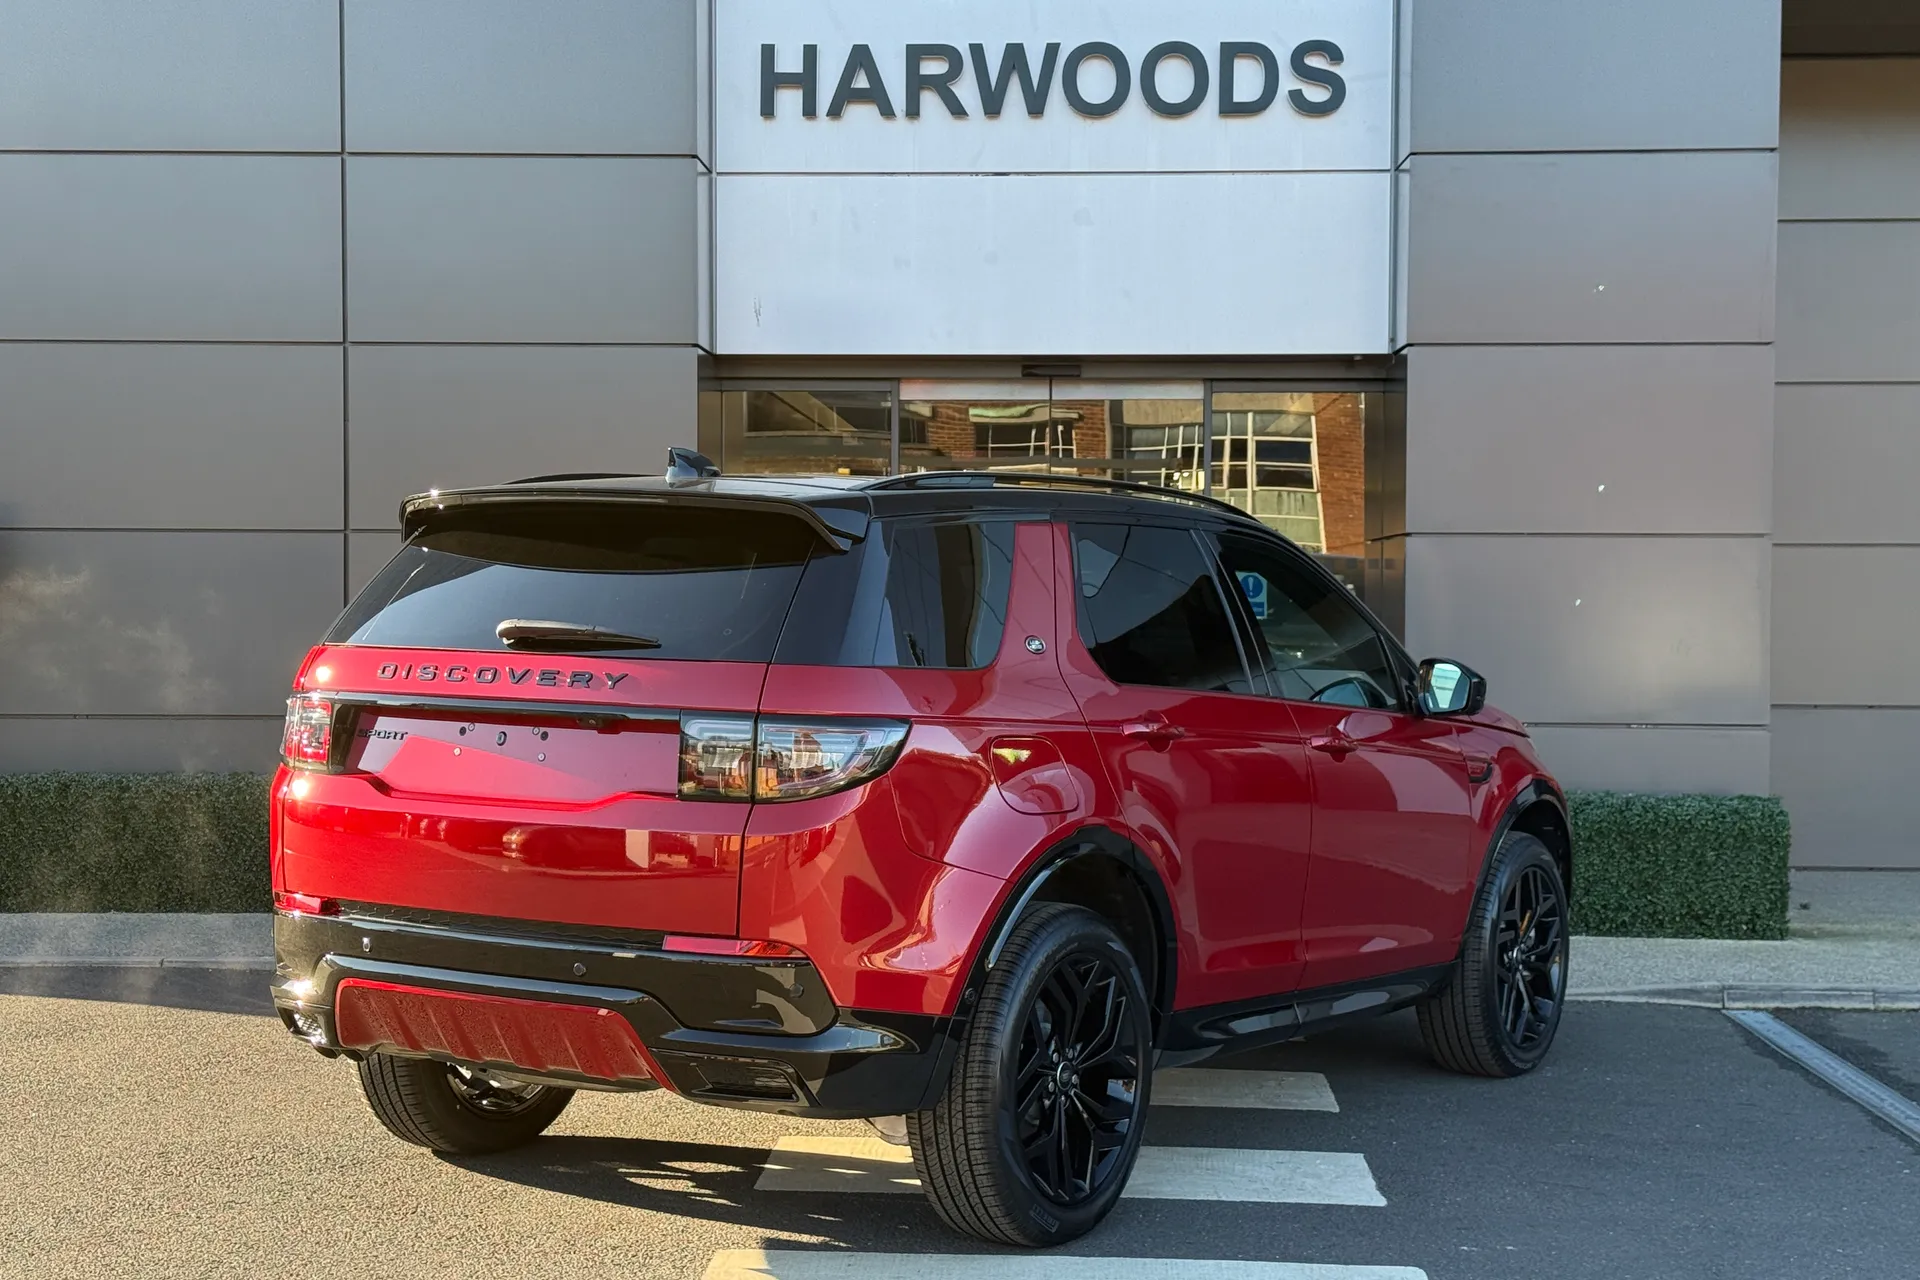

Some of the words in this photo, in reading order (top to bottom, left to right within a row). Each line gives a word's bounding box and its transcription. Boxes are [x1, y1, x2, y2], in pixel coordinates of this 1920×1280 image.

[760, 40, 1347, 119] HARWOODS
[377, 663, 629, 689] DISCOVERY
[357, 728, 408, 741] SPORT
